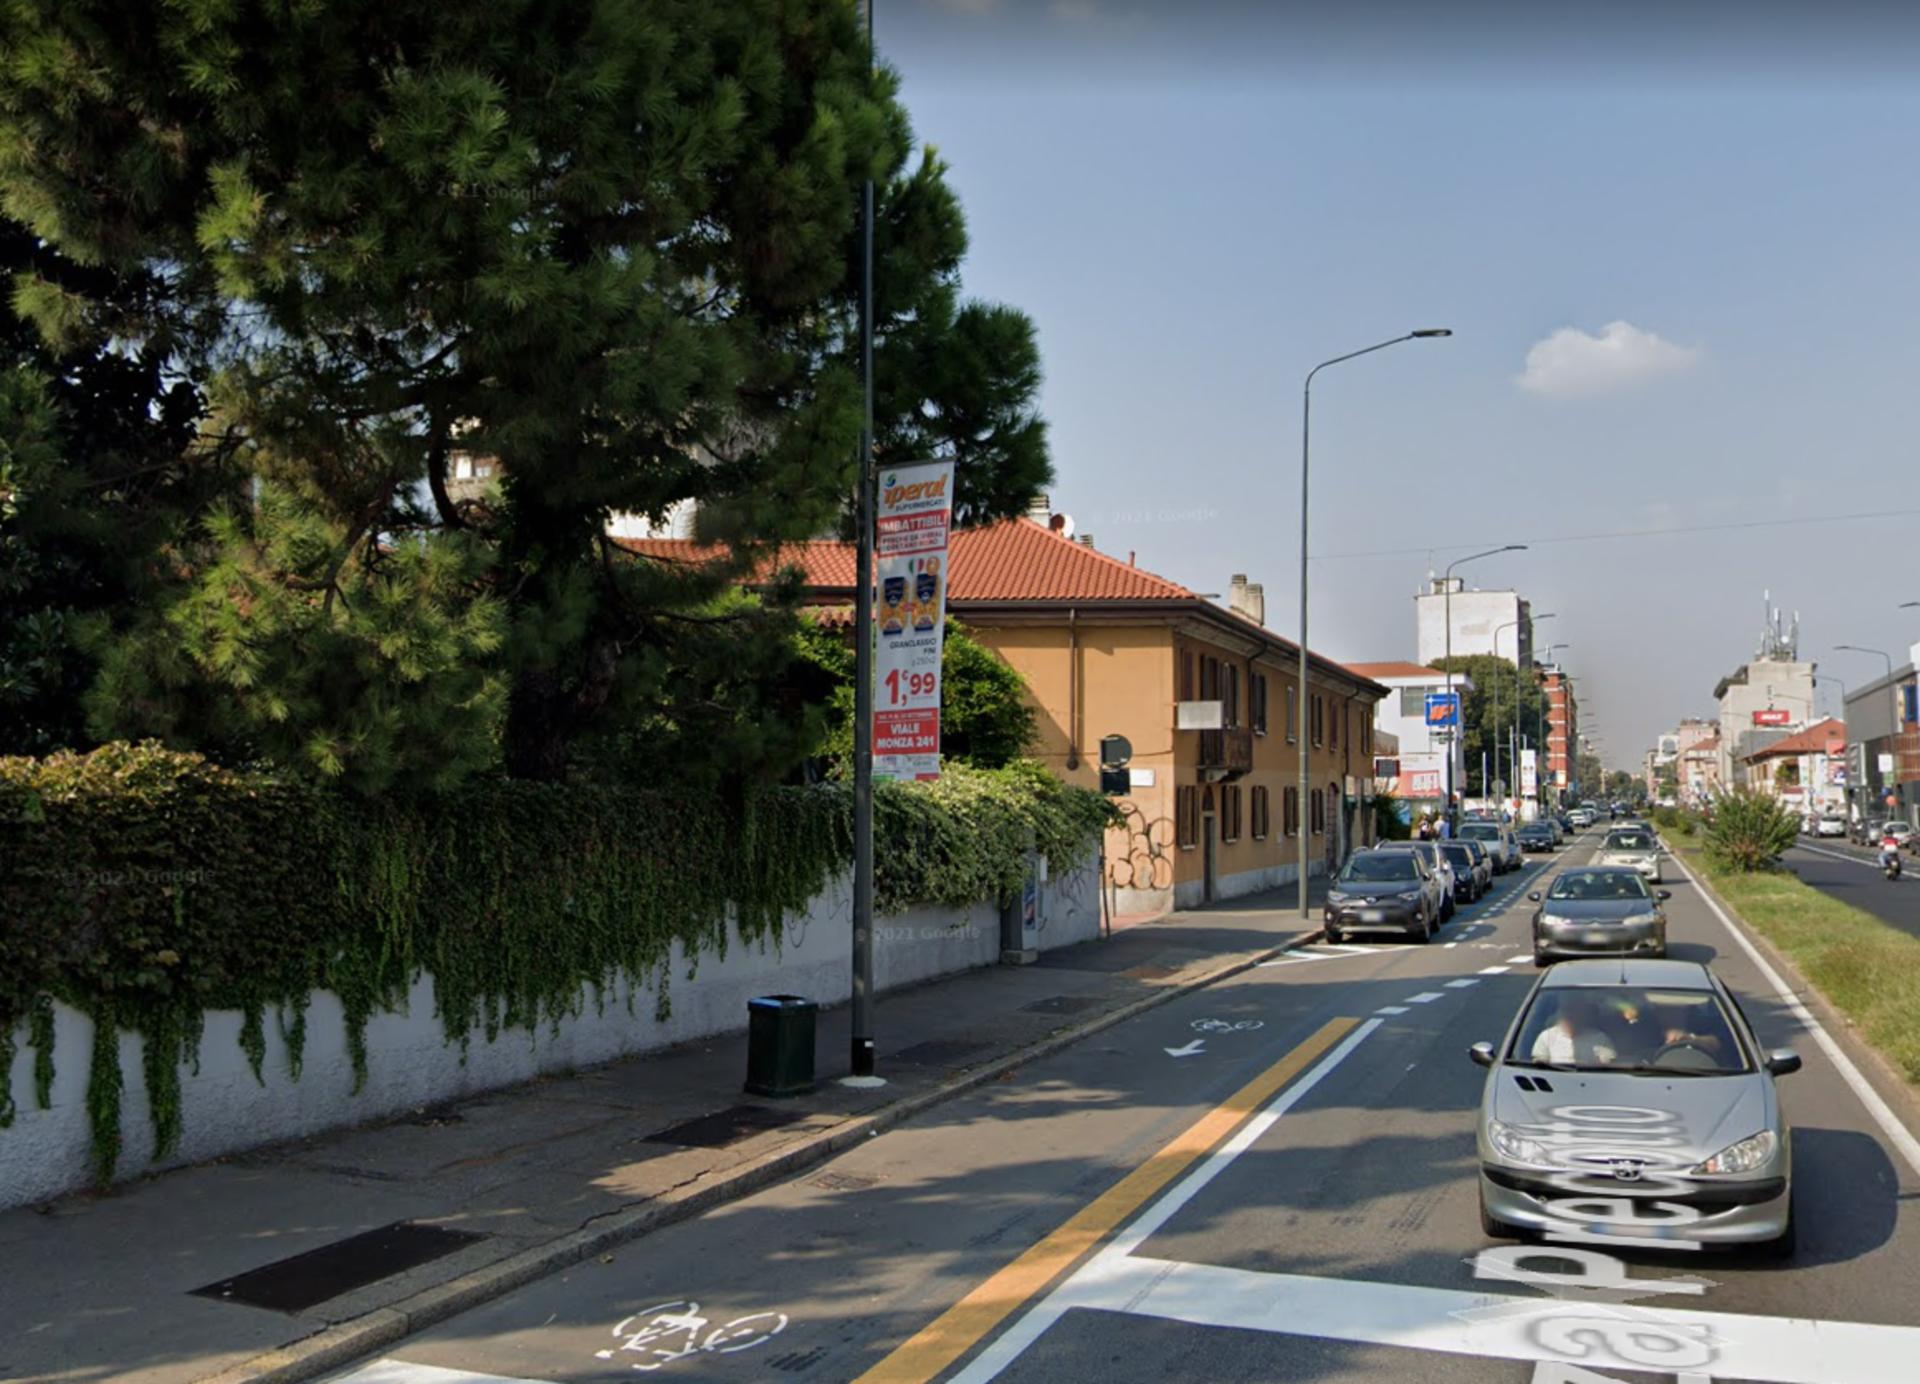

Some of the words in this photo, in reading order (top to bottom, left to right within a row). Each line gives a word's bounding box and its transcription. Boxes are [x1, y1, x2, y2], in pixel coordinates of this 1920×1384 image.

[896, 499, 945, 511] SUPERMERCATI
[880, 513, 948, 533] IMBATTIBILI
[890, 722, 921, 734] VIALE
[876, 737, 913, 749] MONZA
